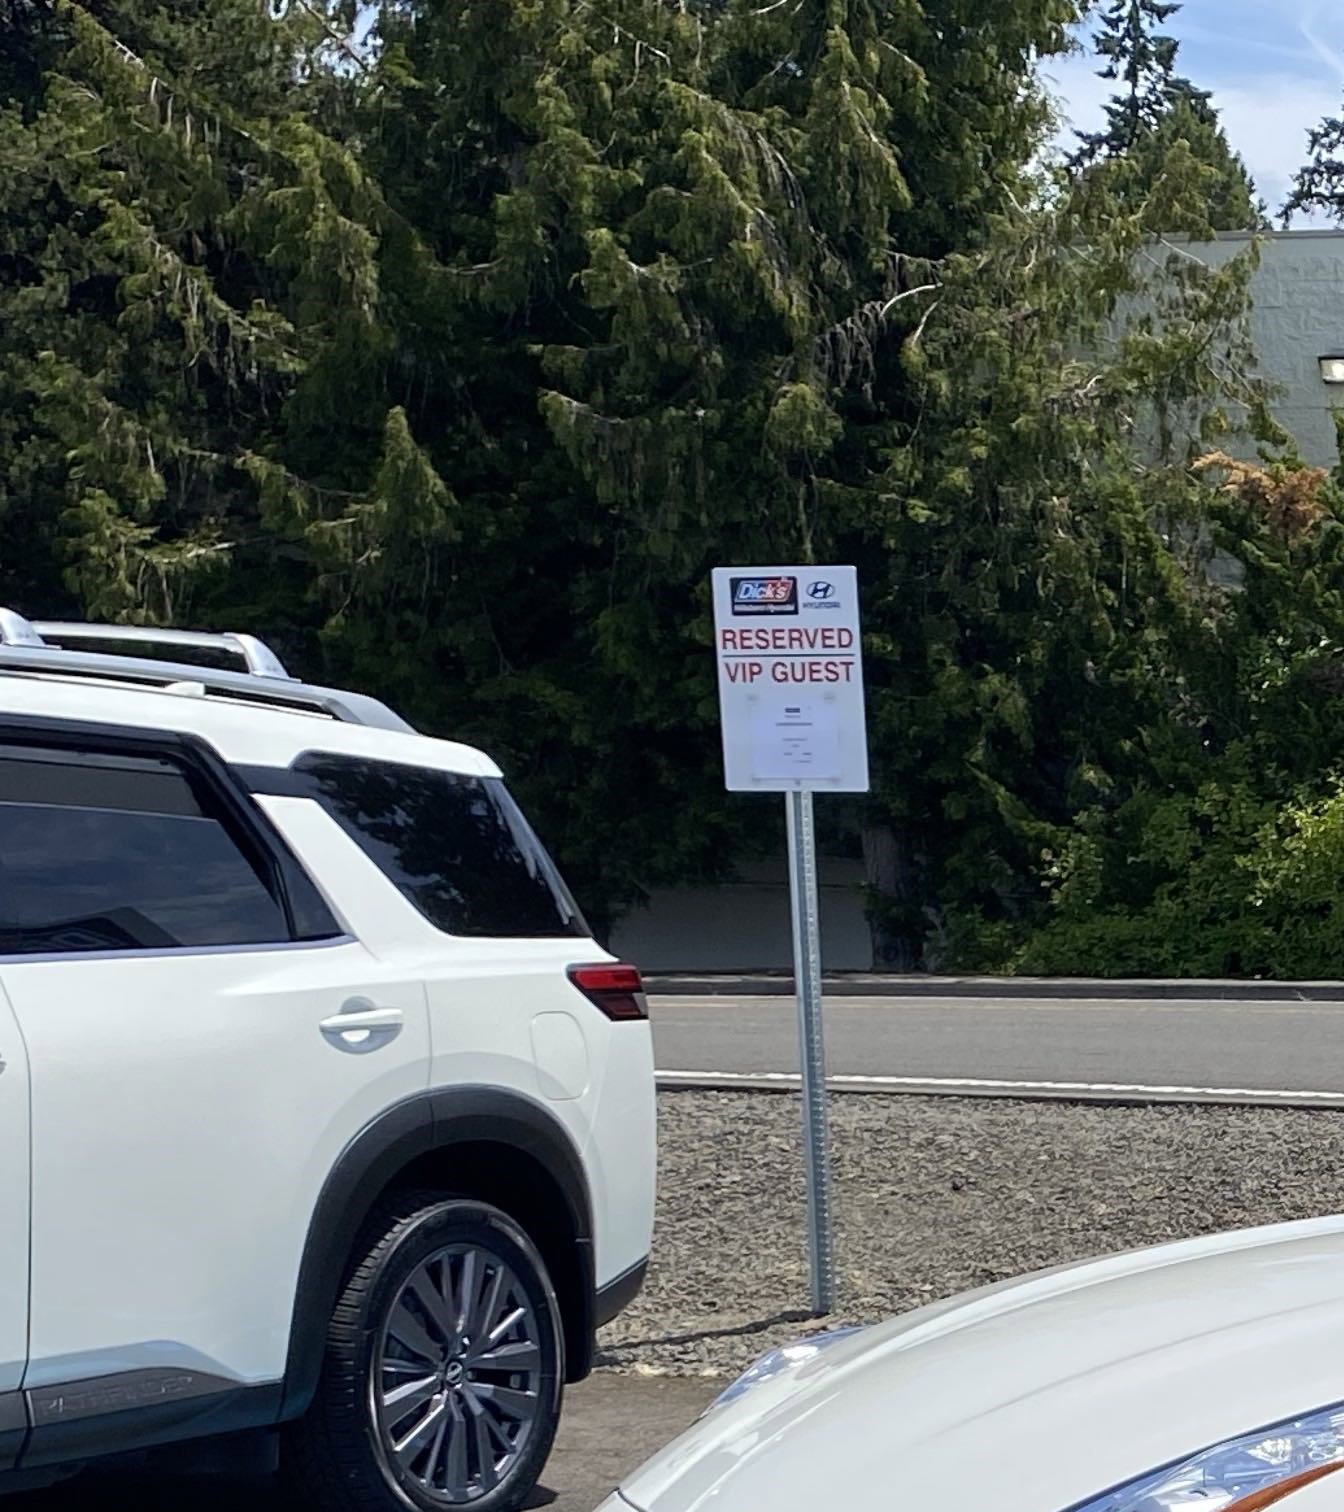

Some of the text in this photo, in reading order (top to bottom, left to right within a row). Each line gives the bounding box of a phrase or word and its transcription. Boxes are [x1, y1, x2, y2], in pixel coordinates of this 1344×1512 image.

[722, 628, 853, 650] RESERVED
[724, 661, 855, 683] VIP GUEST
